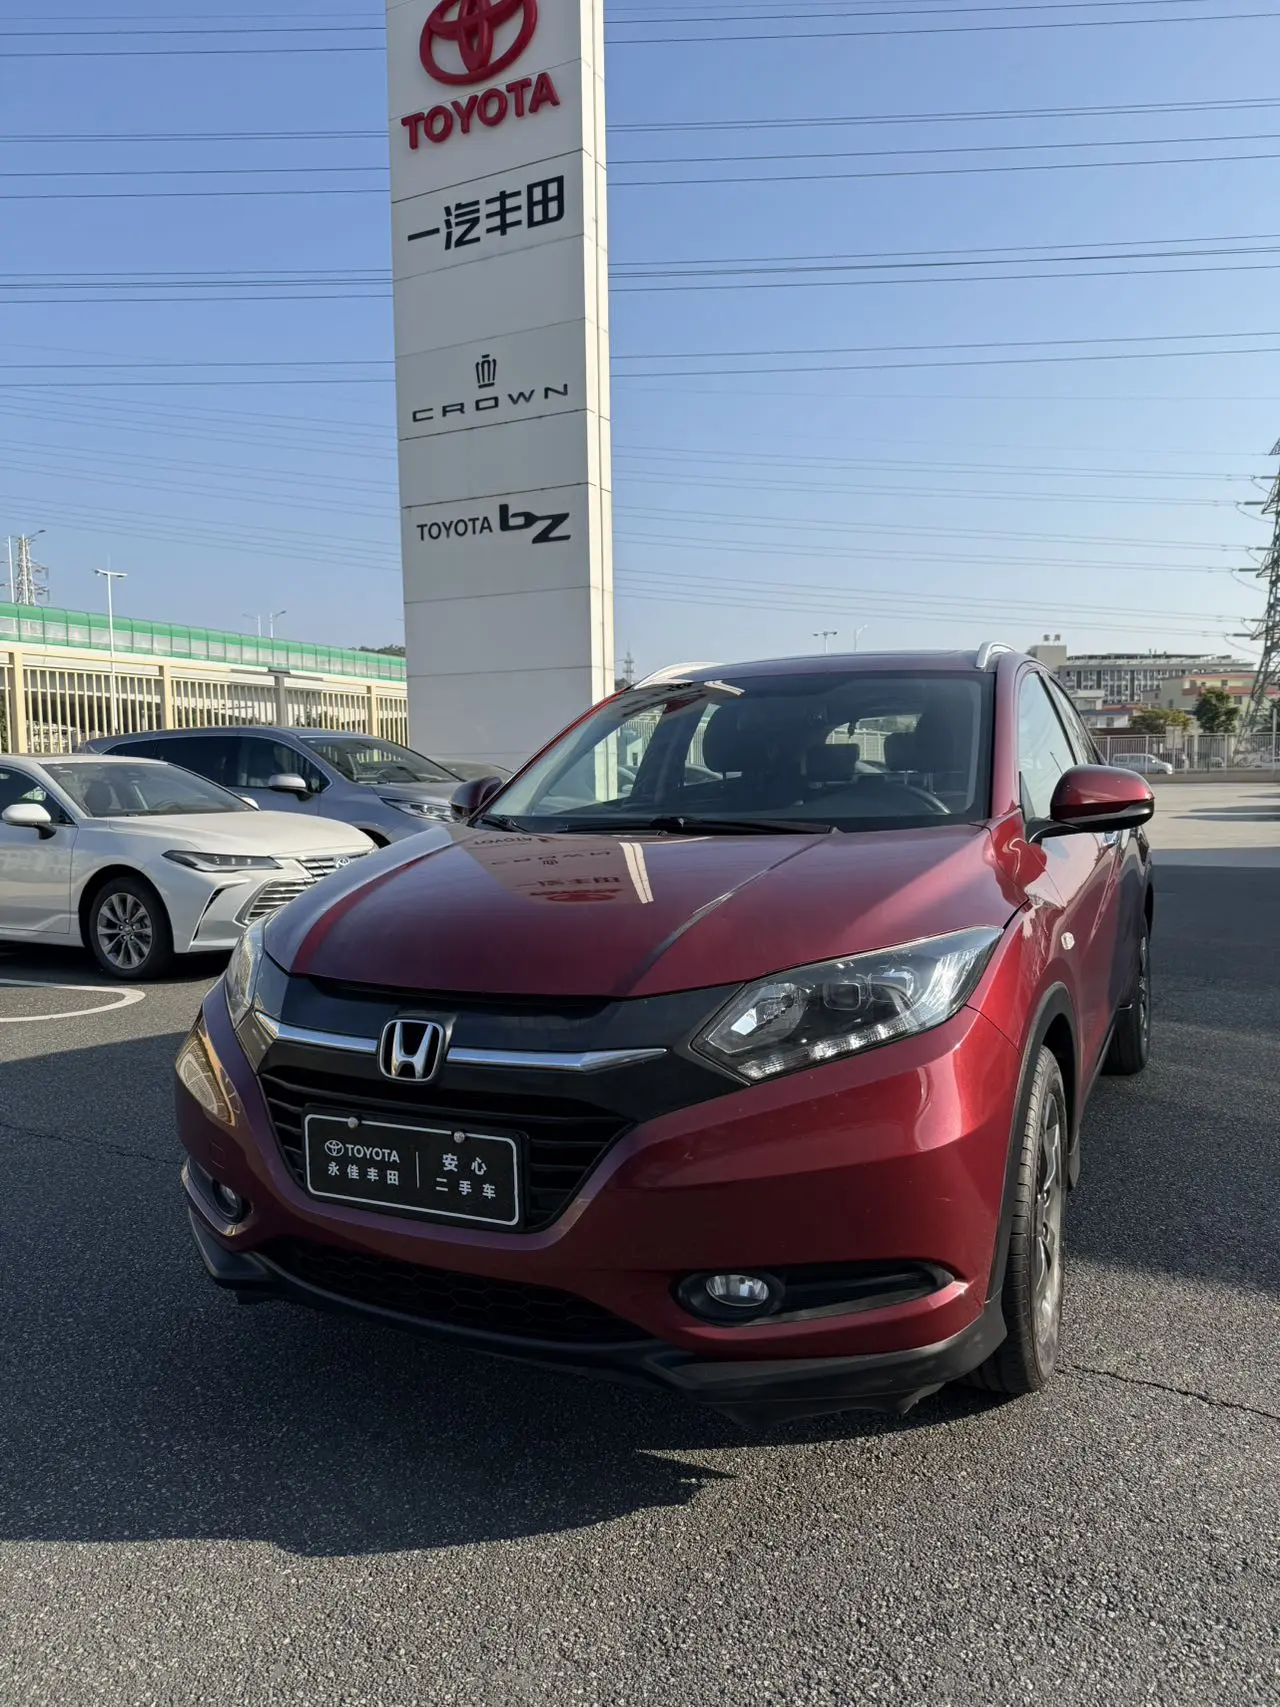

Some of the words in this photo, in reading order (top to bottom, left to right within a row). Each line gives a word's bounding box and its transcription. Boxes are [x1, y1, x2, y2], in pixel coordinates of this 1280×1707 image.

[401, 72, 560, 150] TOYOTA
[407, 175, 564, 250] 一汽丰田
[412, 383, 568, 422] CROWN
[416, 516, 493, 541] TOYOTA
[345, 1143, 400, 1163] TOYOTA
[442, 1153, 487, 1175] 安心
[328, 1161, 399, 1186] 永佳丰田
[435, 1177, 496, 1200] 二手车
